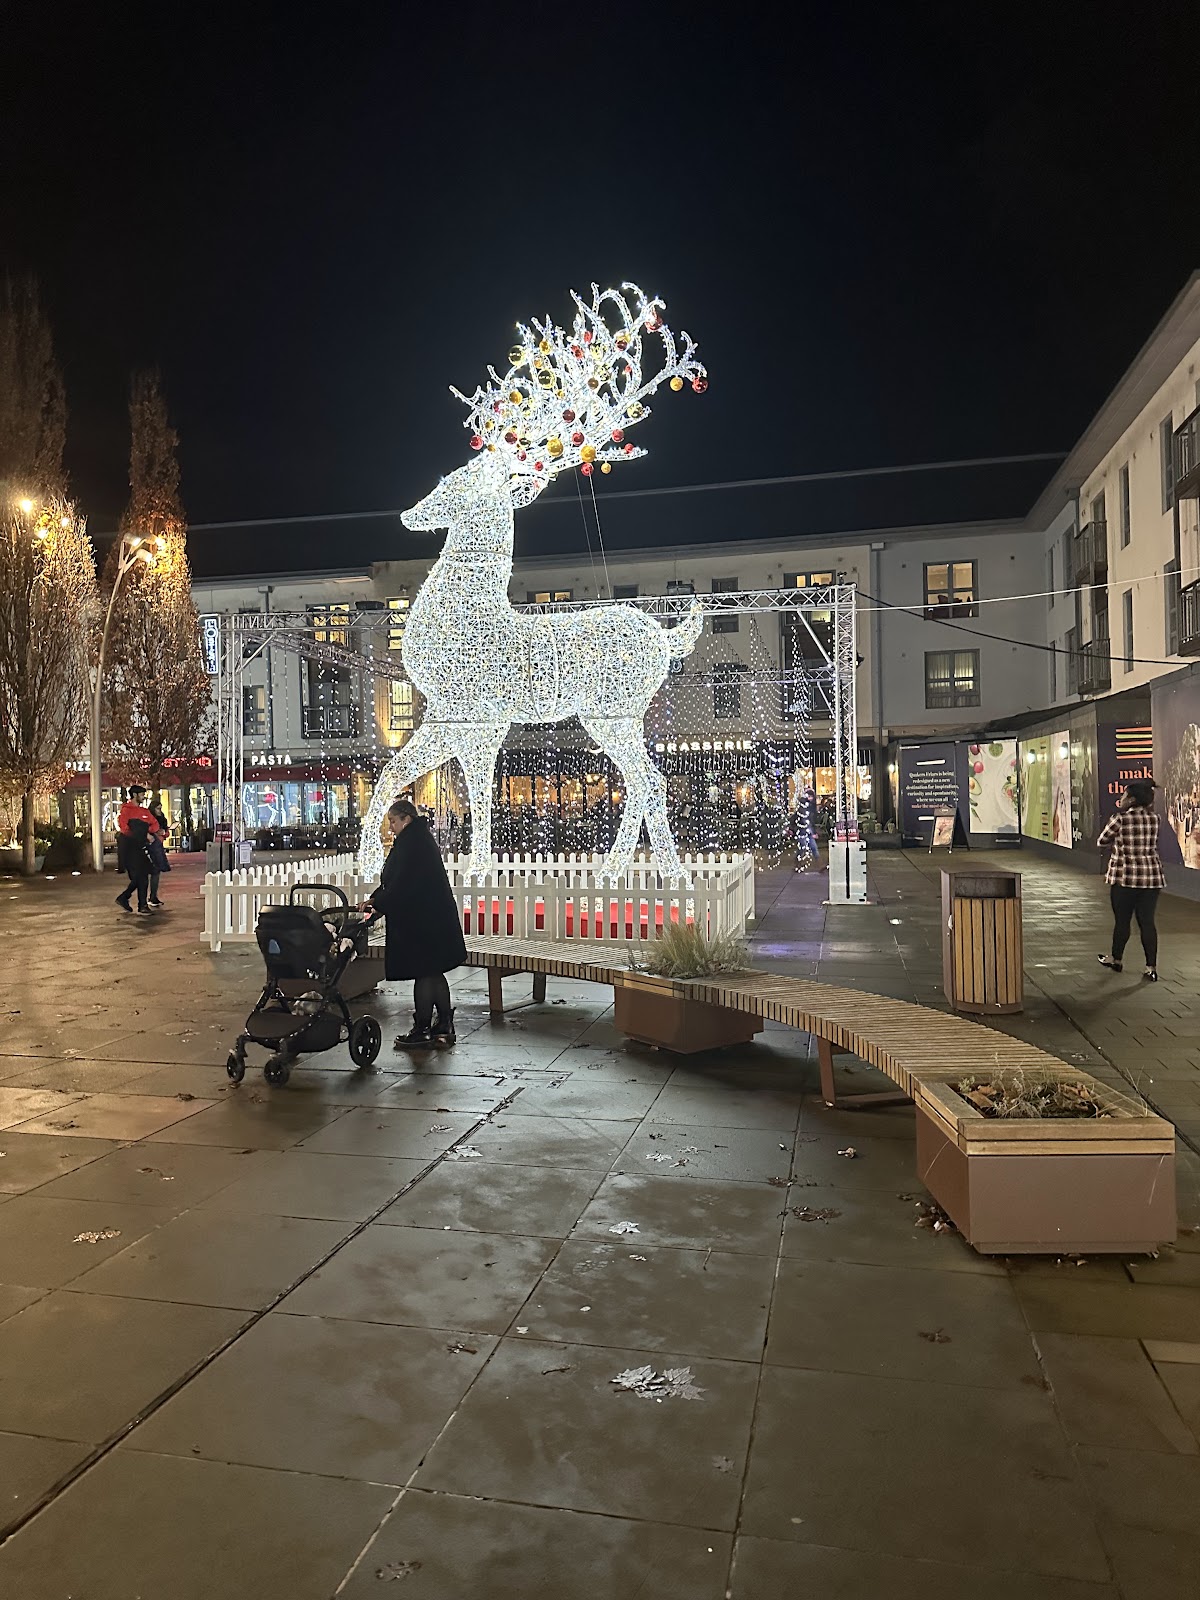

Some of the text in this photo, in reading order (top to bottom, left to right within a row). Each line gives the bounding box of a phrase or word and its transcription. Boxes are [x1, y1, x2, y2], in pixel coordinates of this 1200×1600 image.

[655, 740, 753, 753] BRASSERIE
[65, 760, 92, 772] PIZZ
[251, 754, 292, 766] PASTA
[1119, 766, 1154, 780] mak
